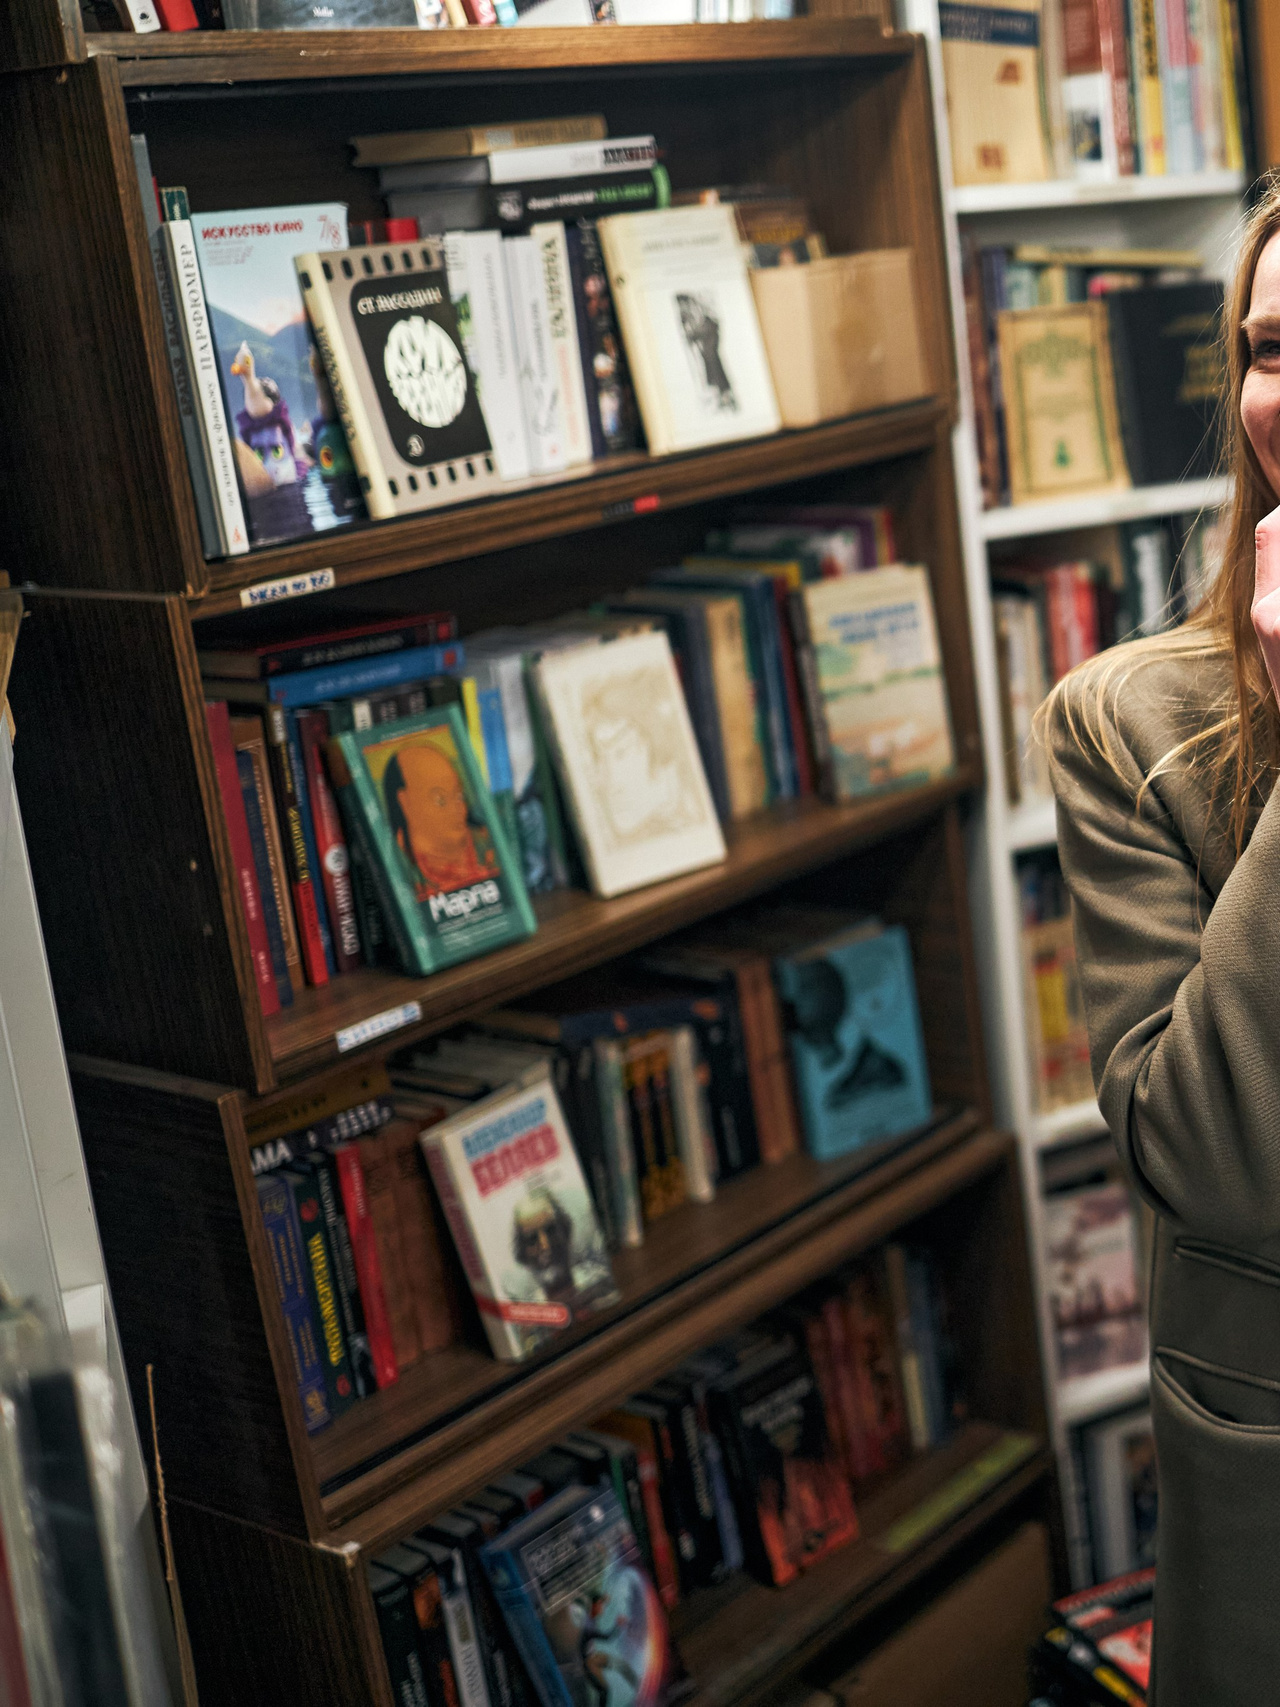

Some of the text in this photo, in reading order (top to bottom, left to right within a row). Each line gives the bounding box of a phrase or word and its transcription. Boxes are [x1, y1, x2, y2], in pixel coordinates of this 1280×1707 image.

[201, 219, 304, 240] ИСКУССТВО КИНО
[180, 243, 213, 370] ПАРФЮМЕР
